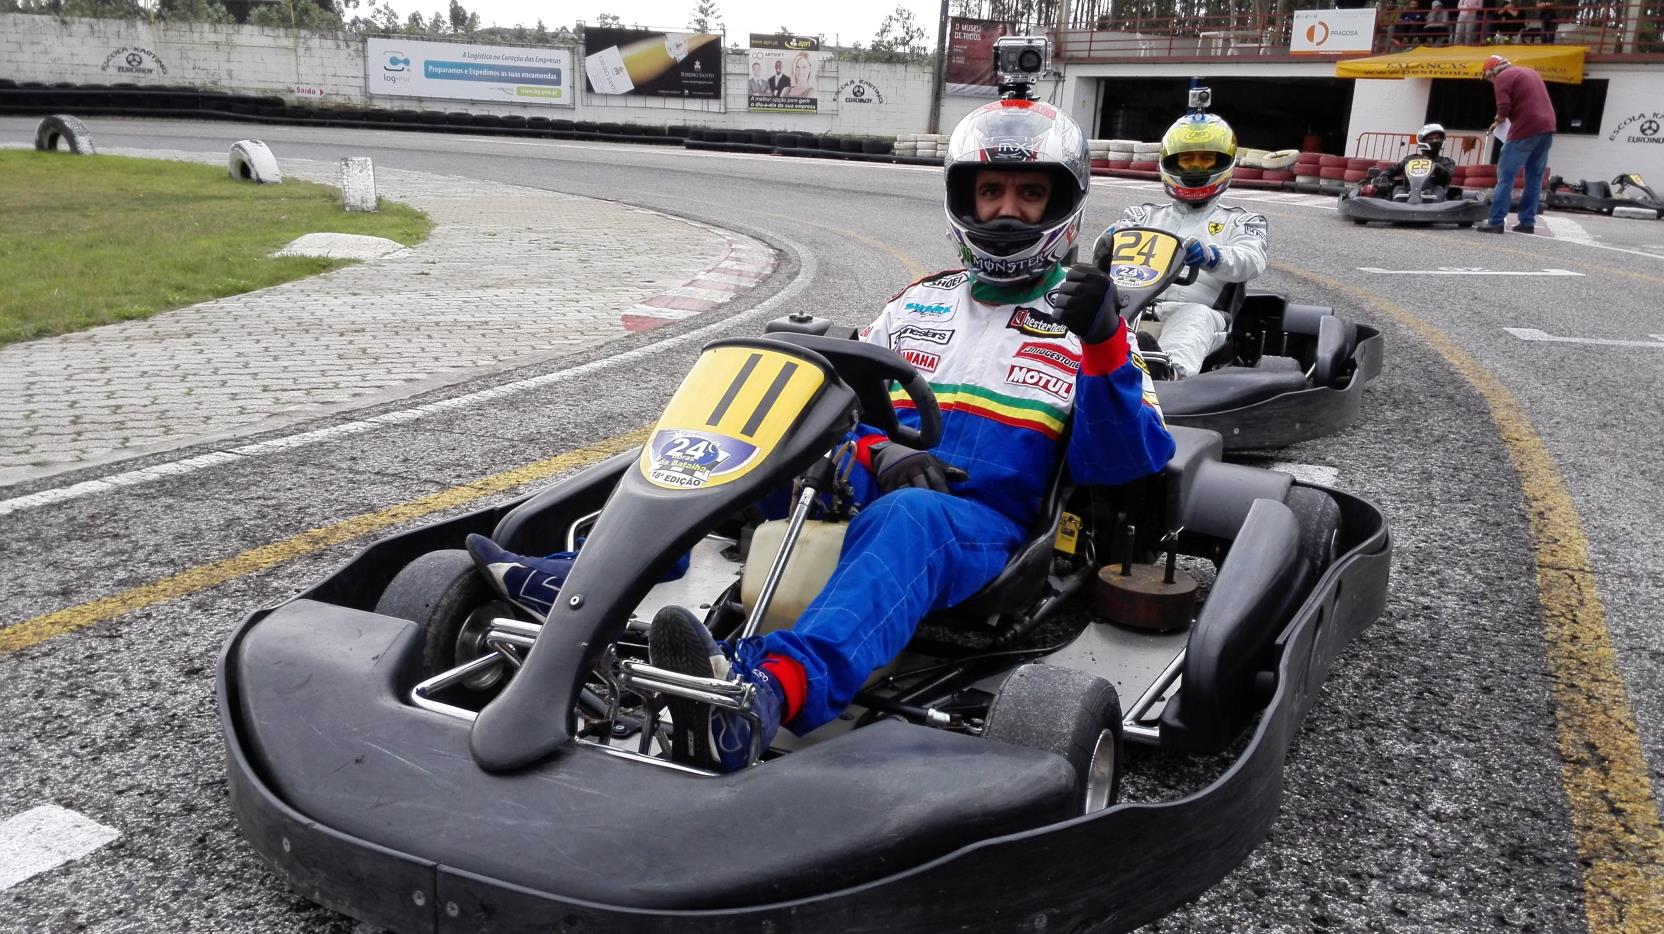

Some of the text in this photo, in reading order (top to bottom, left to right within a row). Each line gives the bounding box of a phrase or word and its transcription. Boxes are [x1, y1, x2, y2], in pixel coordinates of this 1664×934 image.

[955, 23, 981, 33] O MUSEU
[963, 32, 981, 41] TODOS
[101, 47, 168, 75] ESCOLA KARTING
[535, 57, 562, 65] Empresas
[428, 65, 464, 75] Preparamos
[470, 69, 500, 77] Expedimos
[1608, 112, 1646, 142] ESCOLA
[1627, 136, 1664, 144] EUROIND
[1411, 160, 1430, 171] 22
[1112, 231, 1159, 267] 24
[973, 254, 1045, 274] MONSTER
[1023, 346, 1081, 369] BRIDGESTONE
[1009, 366, 1074, 399] MOTUL
[705, 353, 800, 439] 11
[665, 438, 709, 460] 24
[671, 459, 707, 473] Batalha
[664, 474, 701, 487] EDIÇÃO
